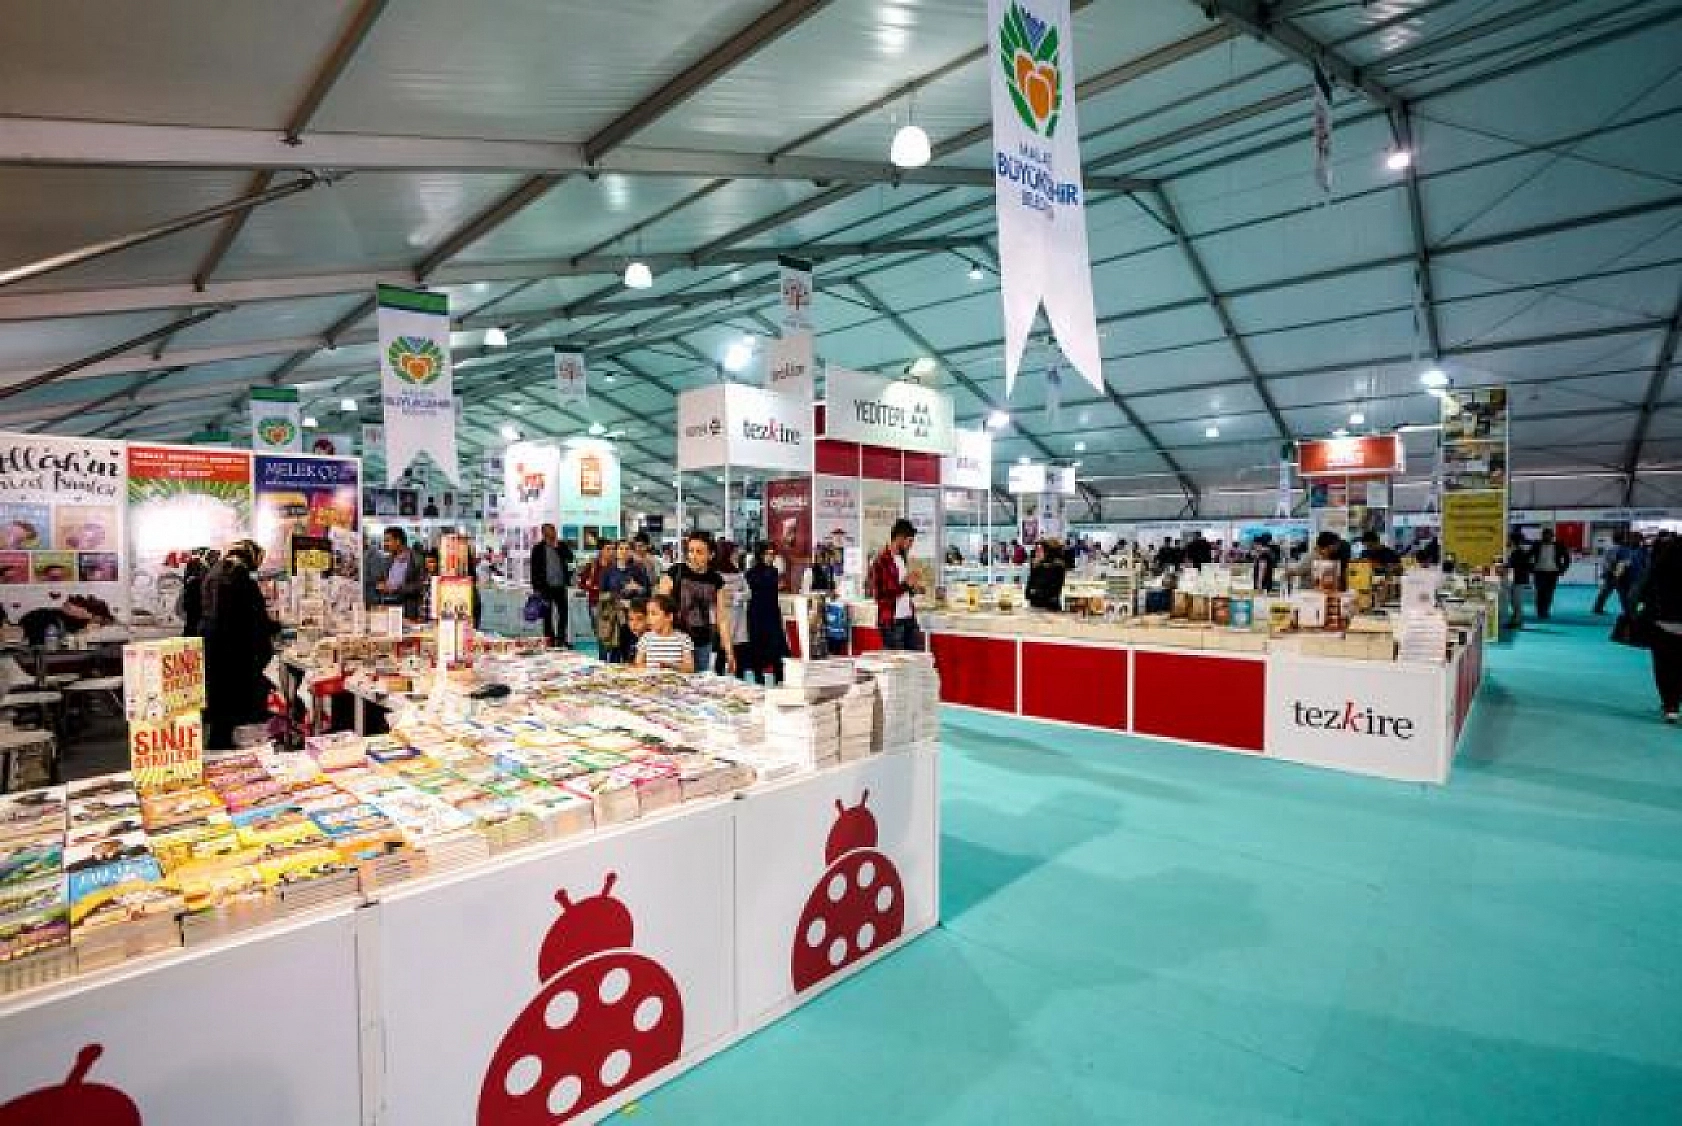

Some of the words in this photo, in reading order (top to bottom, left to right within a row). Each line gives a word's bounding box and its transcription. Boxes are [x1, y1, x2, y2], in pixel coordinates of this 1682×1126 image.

[742, 418, 800, 446] tezkire
[1294, 700, 1415, 740] tezkire
[134, 722, 199, 756] SINIF
